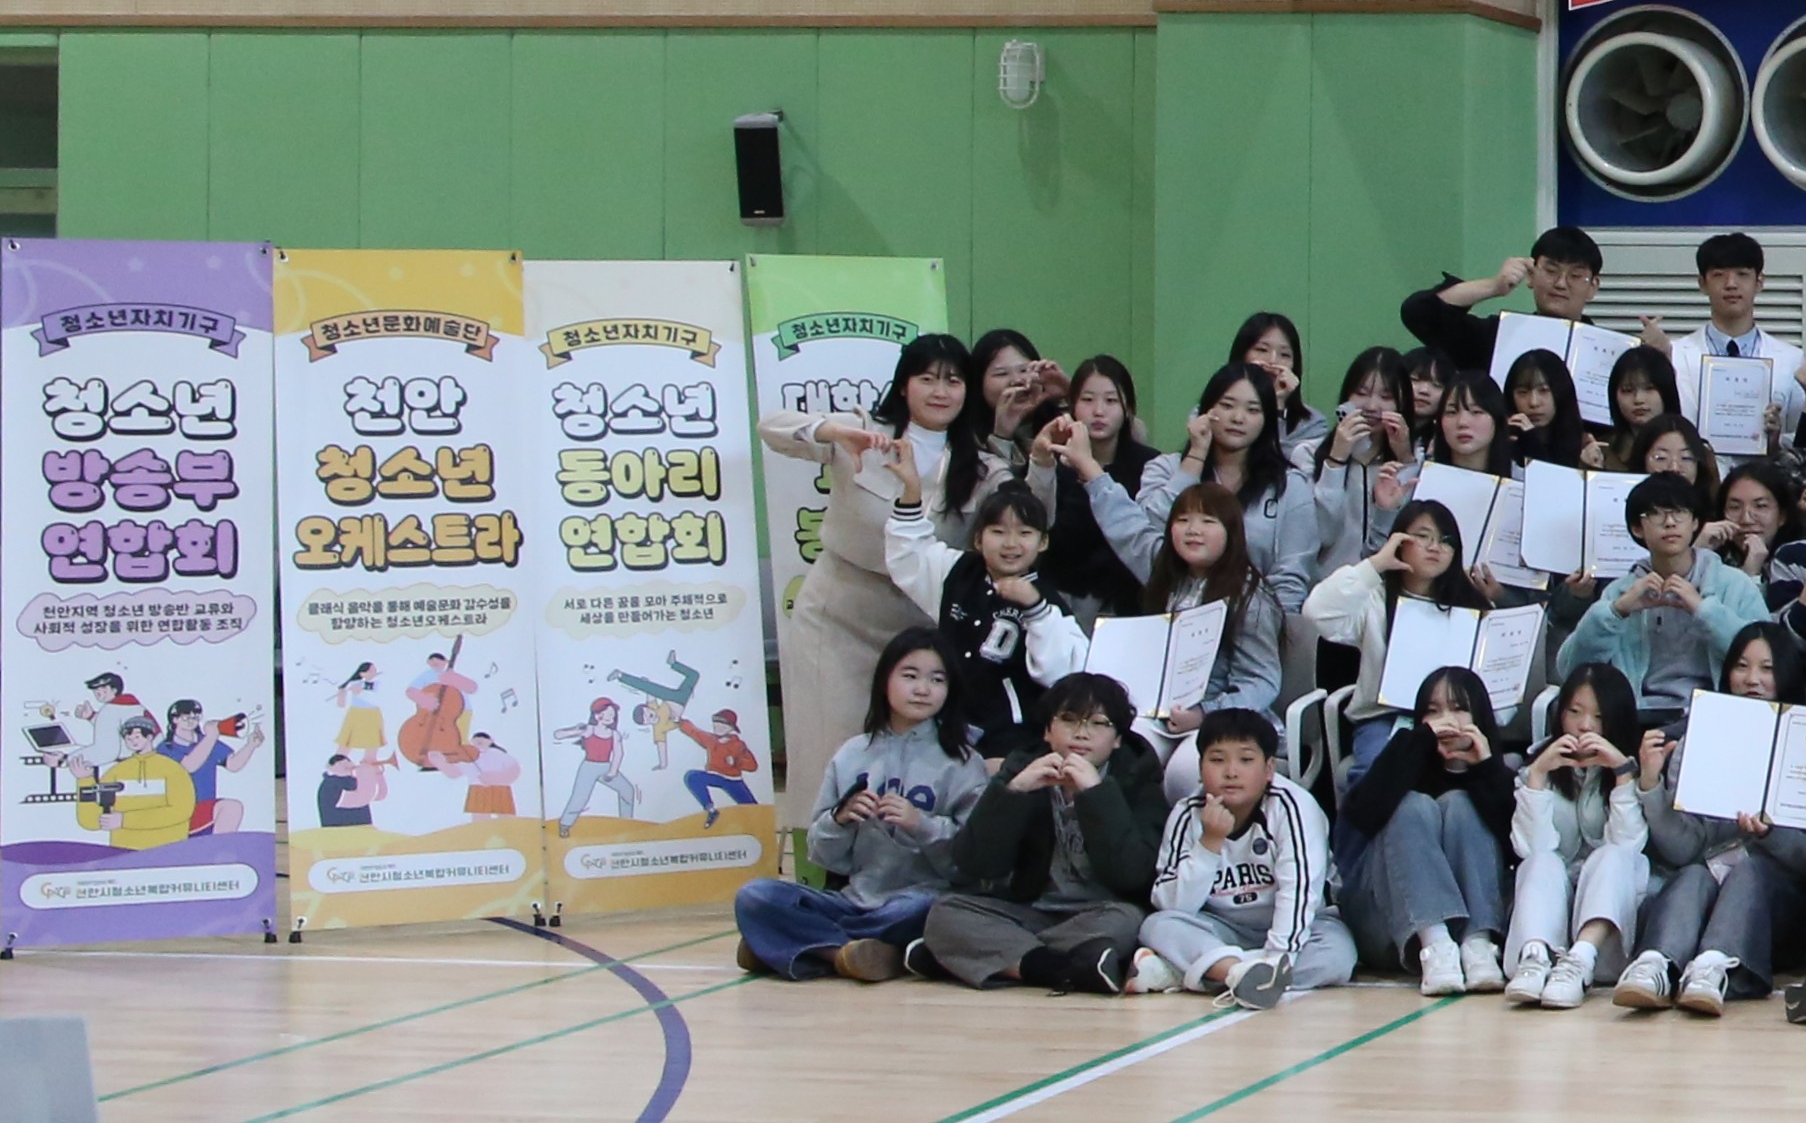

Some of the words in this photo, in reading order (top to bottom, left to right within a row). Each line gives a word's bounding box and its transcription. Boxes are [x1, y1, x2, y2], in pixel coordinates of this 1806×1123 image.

[61, 308, 219, 334] 청소년자치기구
[321, 315, 482, 342] 청소년문화예술단
[563, 323, 698, 346] 청소년자치기구
[791, 317, 907, 341] 청소년자치기구
[42, 377, 237, 441] 청소년
[343, 376, 467, 436] 천안
[552, 381, 719, 442] 청소년
[42, 448, 239, 512] 방송부
[316, 443, 496, 507] 청소년
[556, 446, 721, 508] 동아리
[41, 519, 238, 583] 연합회
[293, 509, 524, 572] 오케스트라
[559, 510, 727, 572] 연합회
[43, 605, 99, 619] 천안지역
[103, 604, 144, 618] 청소년
[148, 603, 189, 617] 방송반
[193, 602, 233, 616] 교류와
[564, 598, 587, 610] 서로
[590, 597, 614, 609] 다른
[644, 595, 668, 607] 모아
[580, 611, 614, 624] 세상을
[617, 610, 677, 623] 만들어가는
[679, 608, 714, 621] 청소년
[34, 621, 76, 634] 사회적
[80, 620, 122, 634] 성장을
[126, 619, 154, 632] 위한
[216, 617, 243, 631] 조직
[979, 617, 1021, 662] D
[1210, 863, 1275, 896] PARIS
